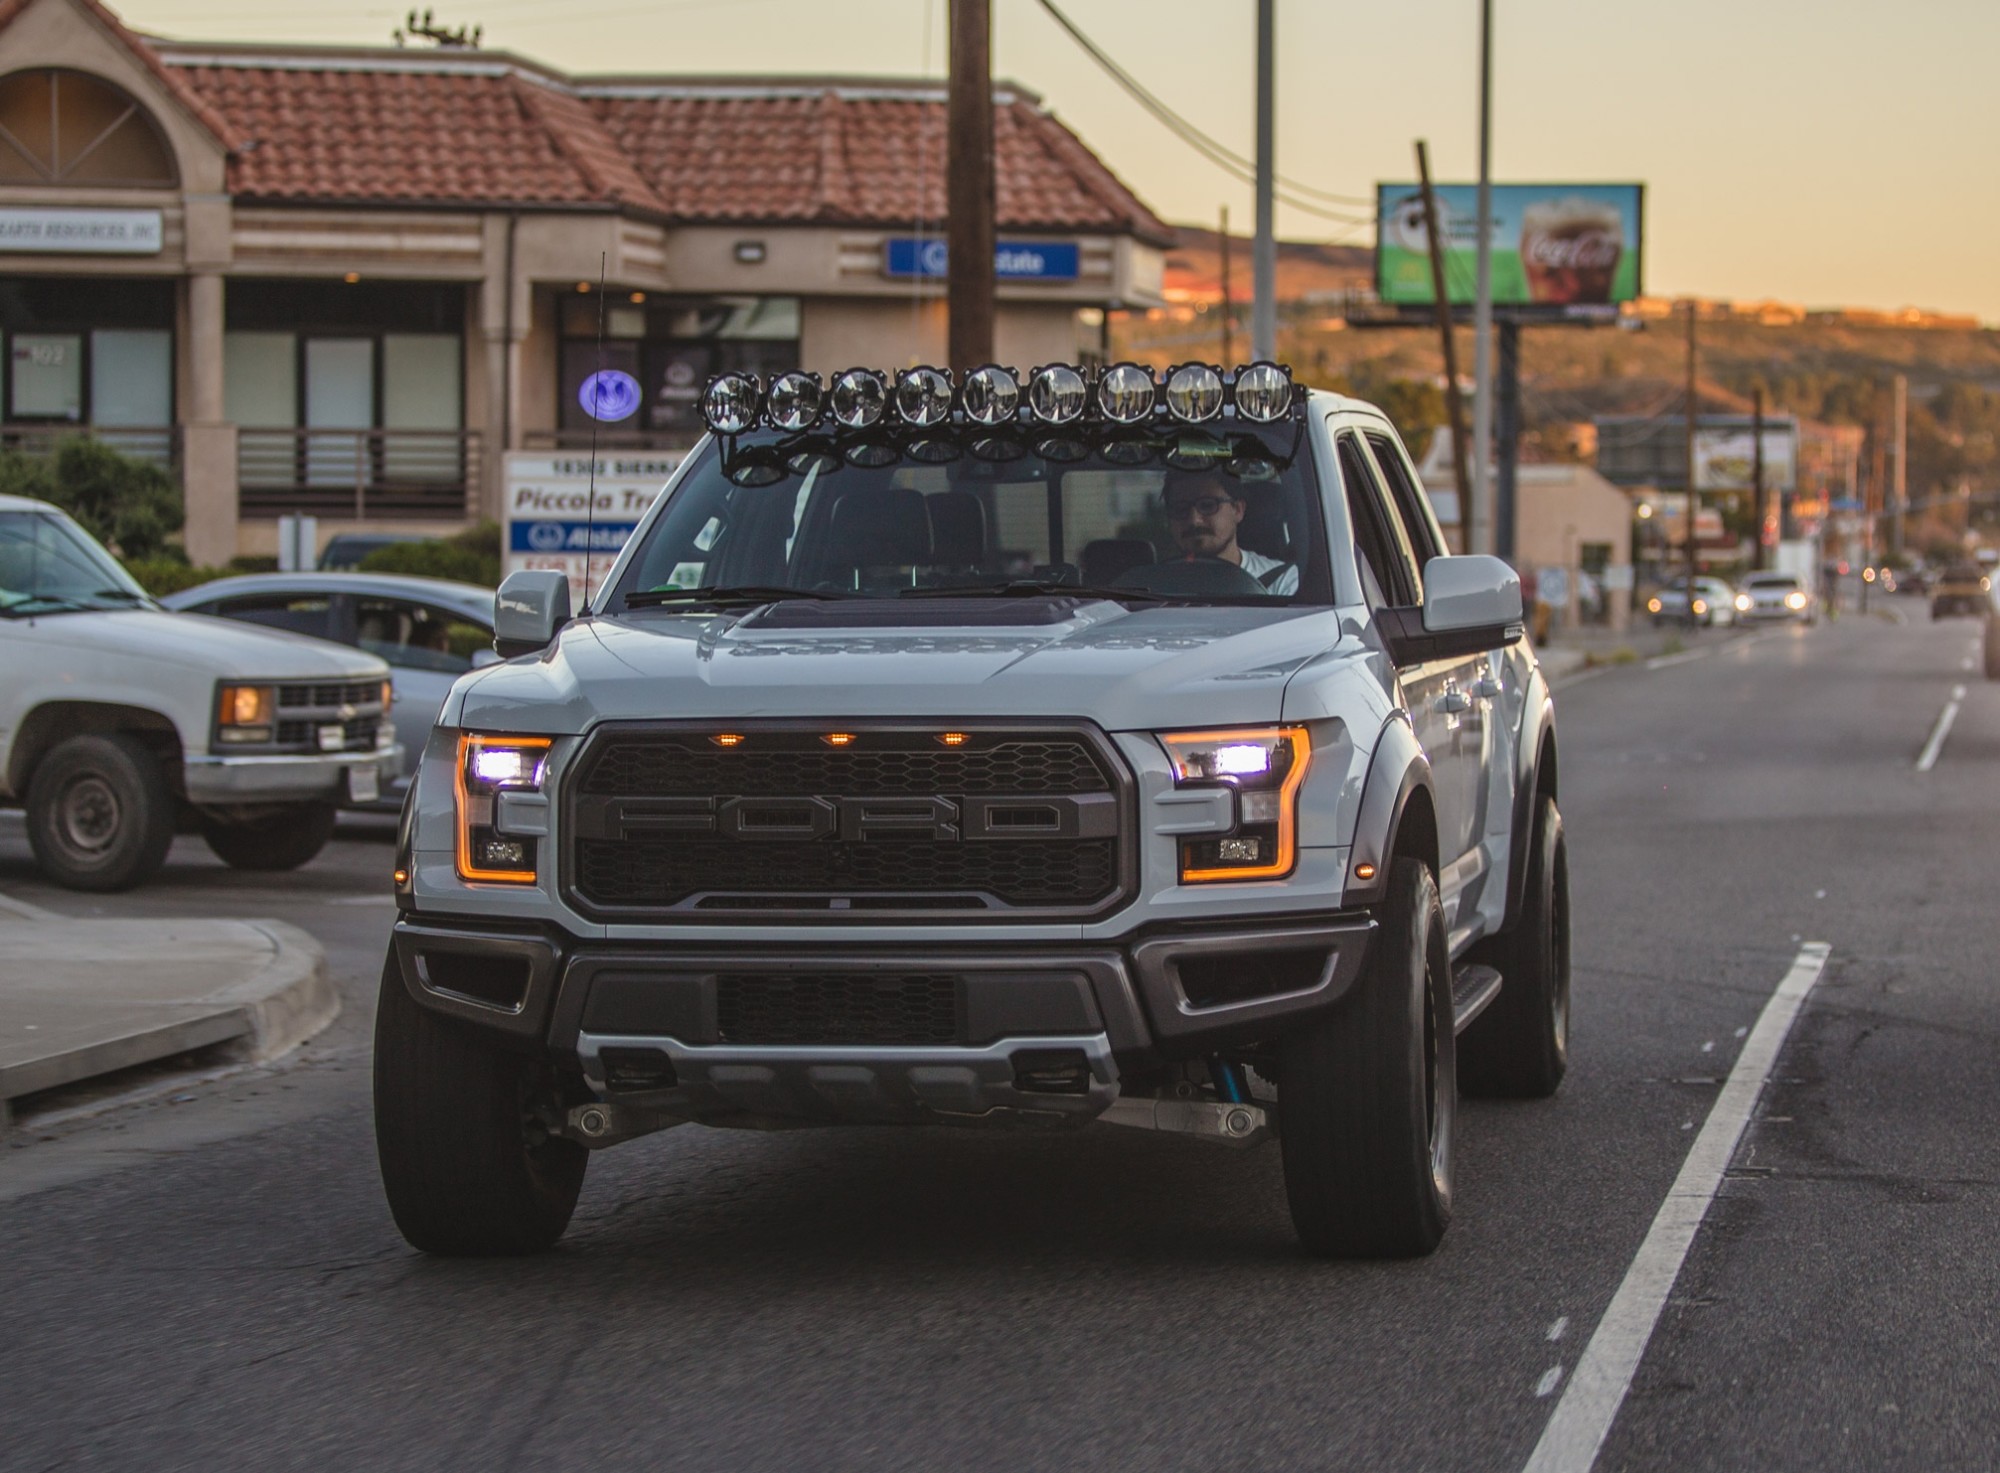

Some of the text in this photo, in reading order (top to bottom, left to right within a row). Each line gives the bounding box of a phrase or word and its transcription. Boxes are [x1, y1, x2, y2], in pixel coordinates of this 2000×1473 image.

[515, 488, 653, 510] Piccola Tr
[605, 796, 1082, 842] FORD
